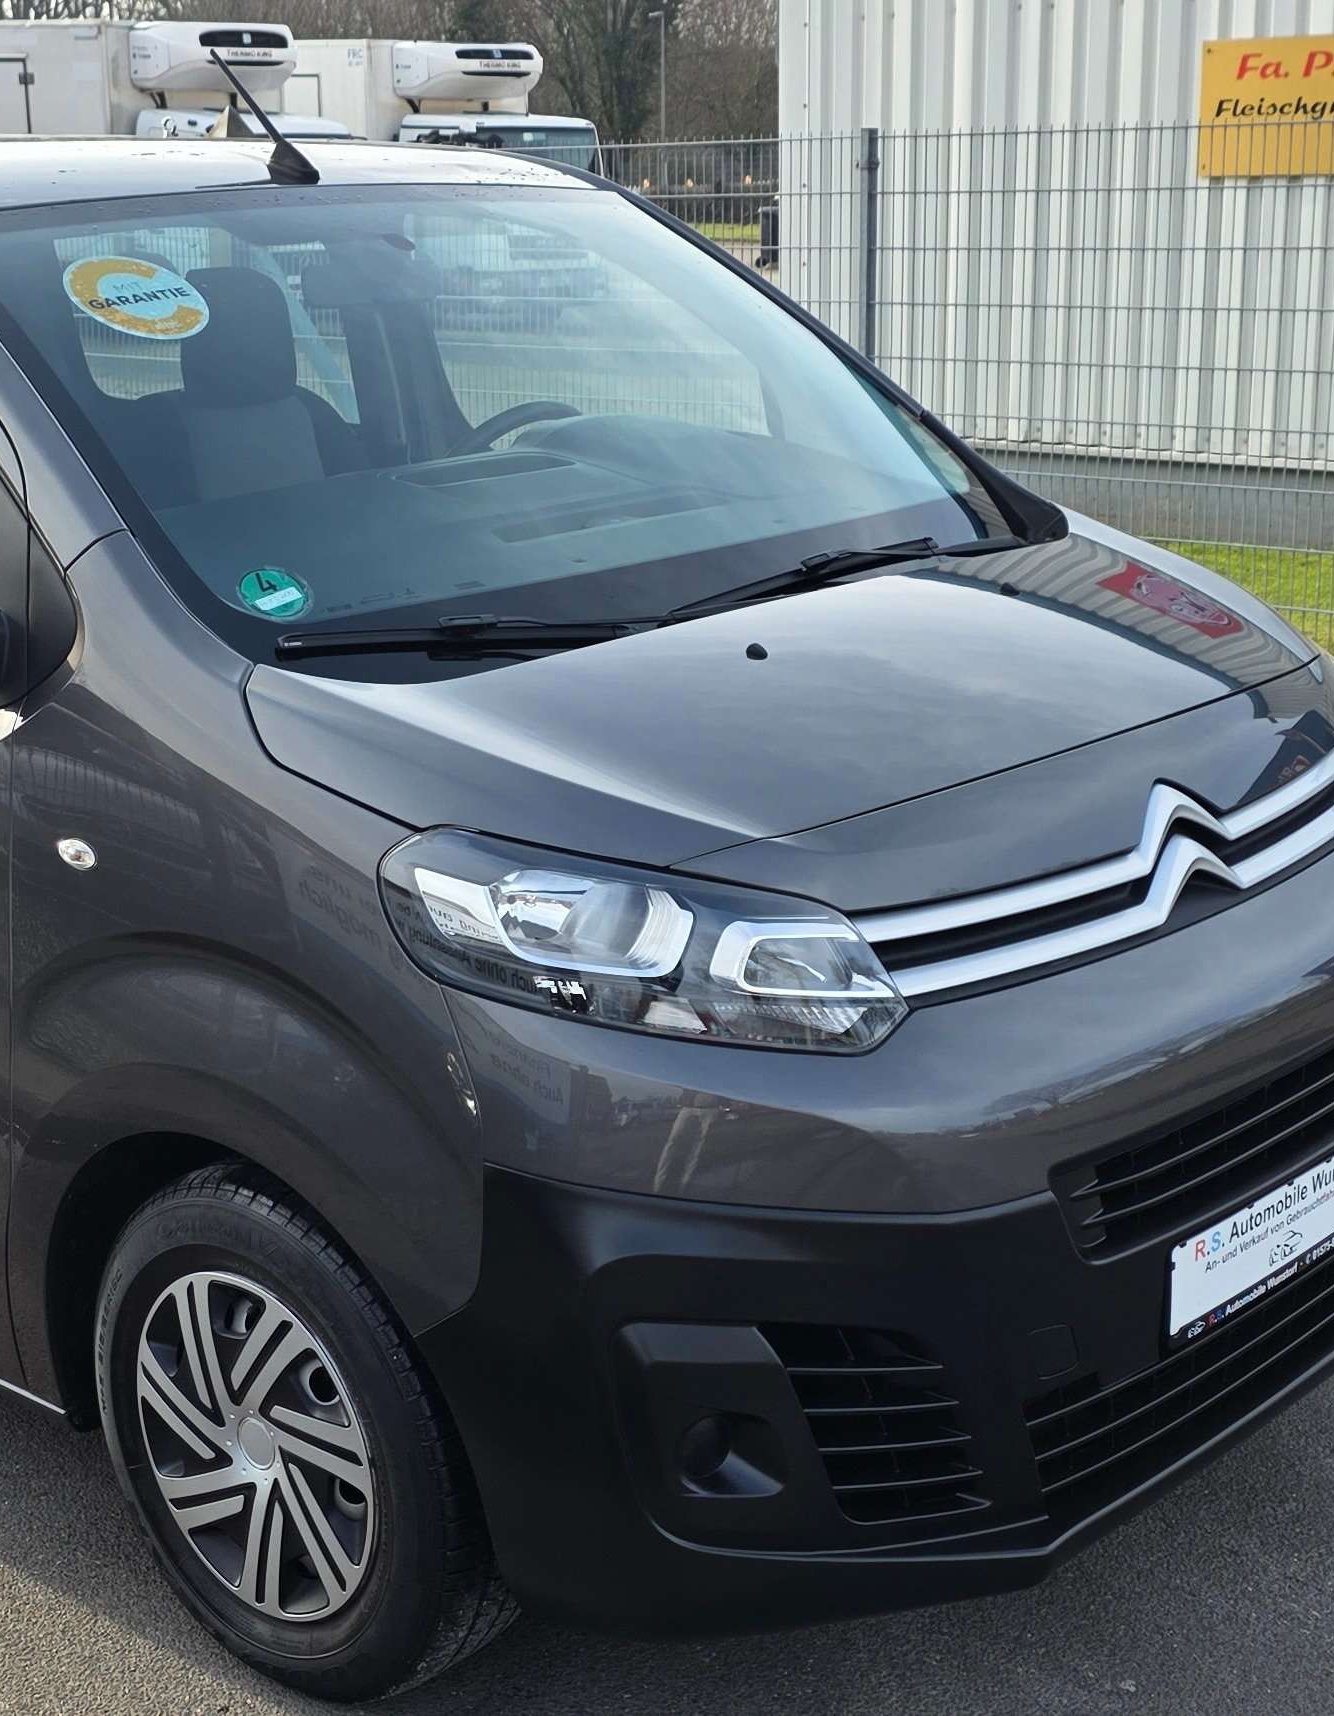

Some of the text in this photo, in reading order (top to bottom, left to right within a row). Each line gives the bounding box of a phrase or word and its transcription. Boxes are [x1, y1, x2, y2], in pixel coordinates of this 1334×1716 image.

[1236, 52, 1289, 81] Fa.
[88, 287, 190, 310] GARANTIE
[255, 572, 278, 593] 4
[1195, 1231, 1225, 1262] R.S.
[1229, 1183, 1308, 1242] Automobile
[1205, 1260, 1219, 1273] An-
[1222, 1249, 1238, 1263] und
[1240, 1232, 1269, 1253] Verkauf
[1270, 1221, 1285, 1234] von
